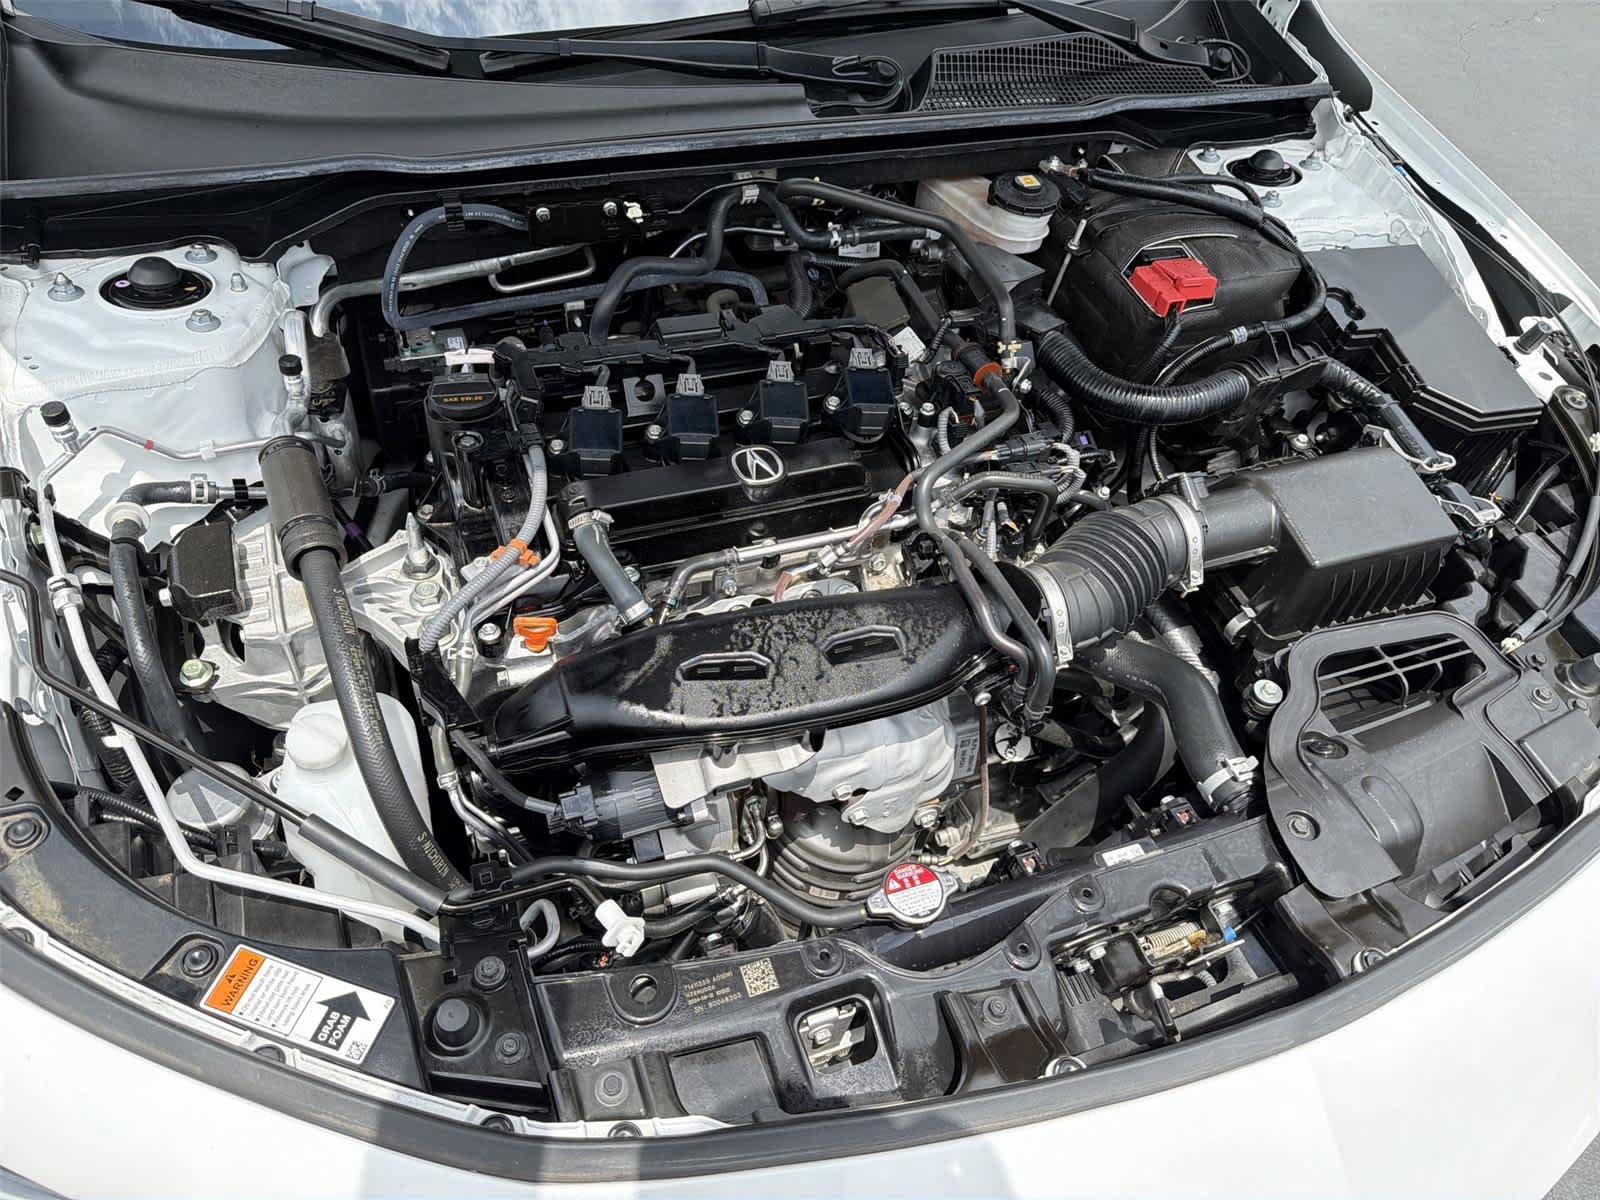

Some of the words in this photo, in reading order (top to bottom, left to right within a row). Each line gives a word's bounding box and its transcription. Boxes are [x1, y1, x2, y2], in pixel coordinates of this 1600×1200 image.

[221, 958, 258, 1006] WARNING
[318, 1011, 340, 1041] GRAB
[328, 1014, 351, 1046] FOAM
